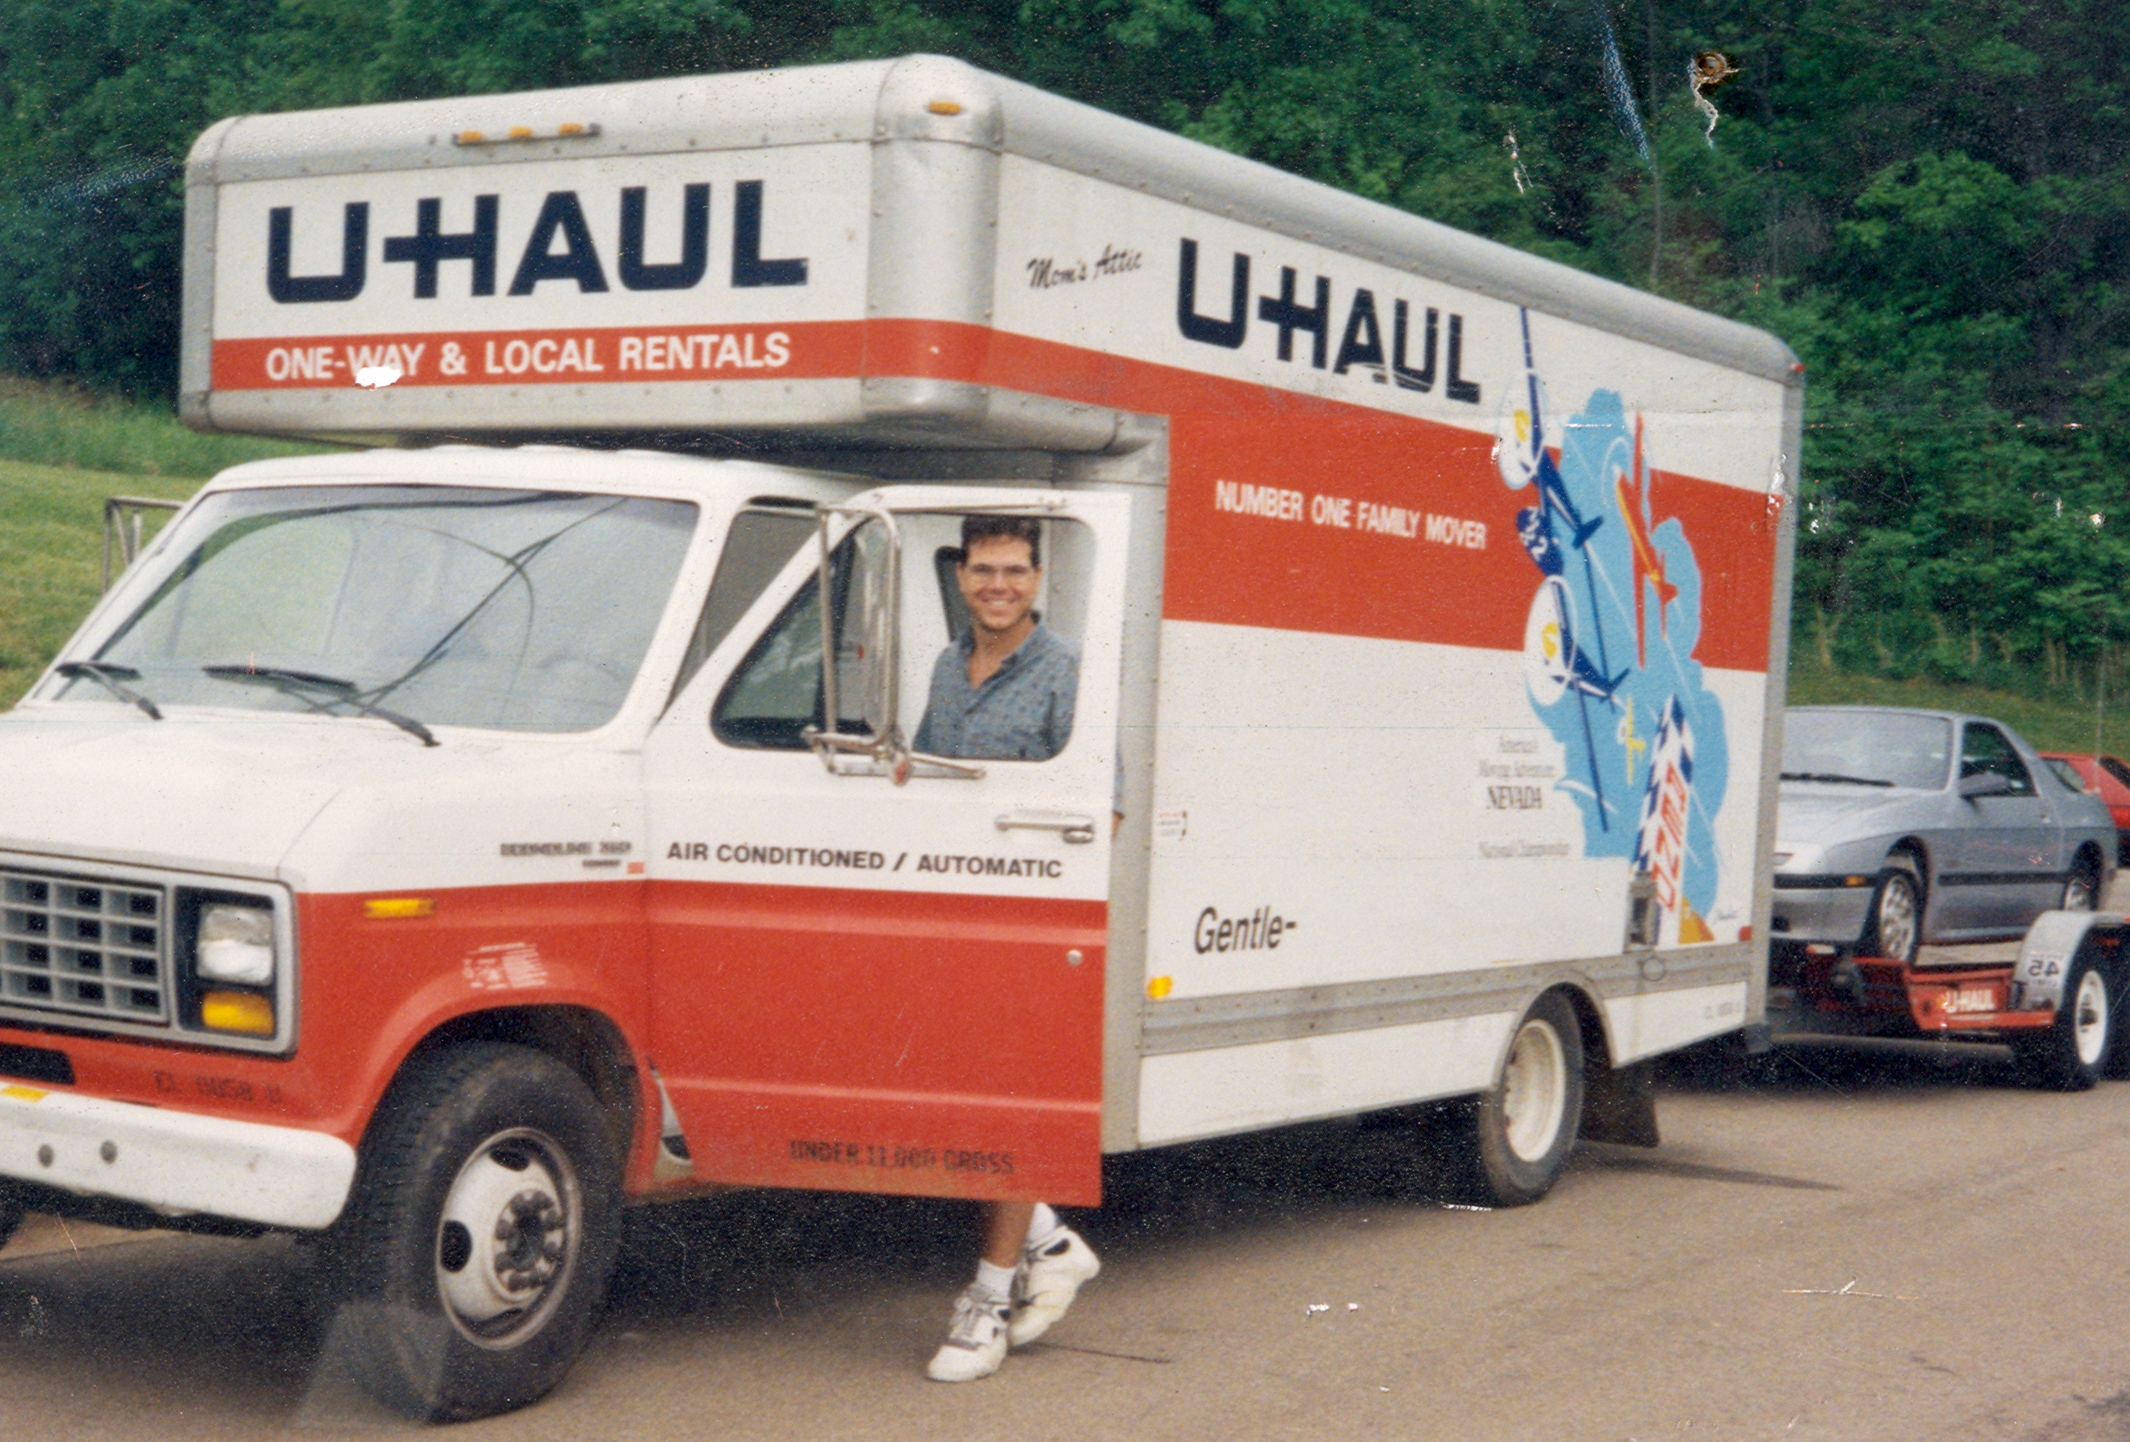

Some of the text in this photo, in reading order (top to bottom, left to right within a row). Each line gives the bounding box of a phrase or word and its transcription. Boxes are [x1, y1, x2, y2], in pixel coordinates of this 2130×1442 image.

[266, 179, 810, 304] U-HAUL
[1026, 243, 1143, 289] Mom's Attic
[1177, 237, 1482, 405] U-HAUL
[265, 331, 791, 381] ONE-WAY & LOCAL RENTALS
[1214, 479, 1303, 522] NUMBER
[1311, 494, 1351, 528] ONE
[1356, 501, 1420, 539] FAMILY
[1424, 513, 1487, 550] MOVER
[667, 841, 710, 862] AIR
[716, 844, 886, 870] CONDITIONED
[917, 854, 1063, 879] AUTOMATIC
[1194, 905, 1297, 956] Gentle-
[790, 1140, 859, 1165] UNDER
